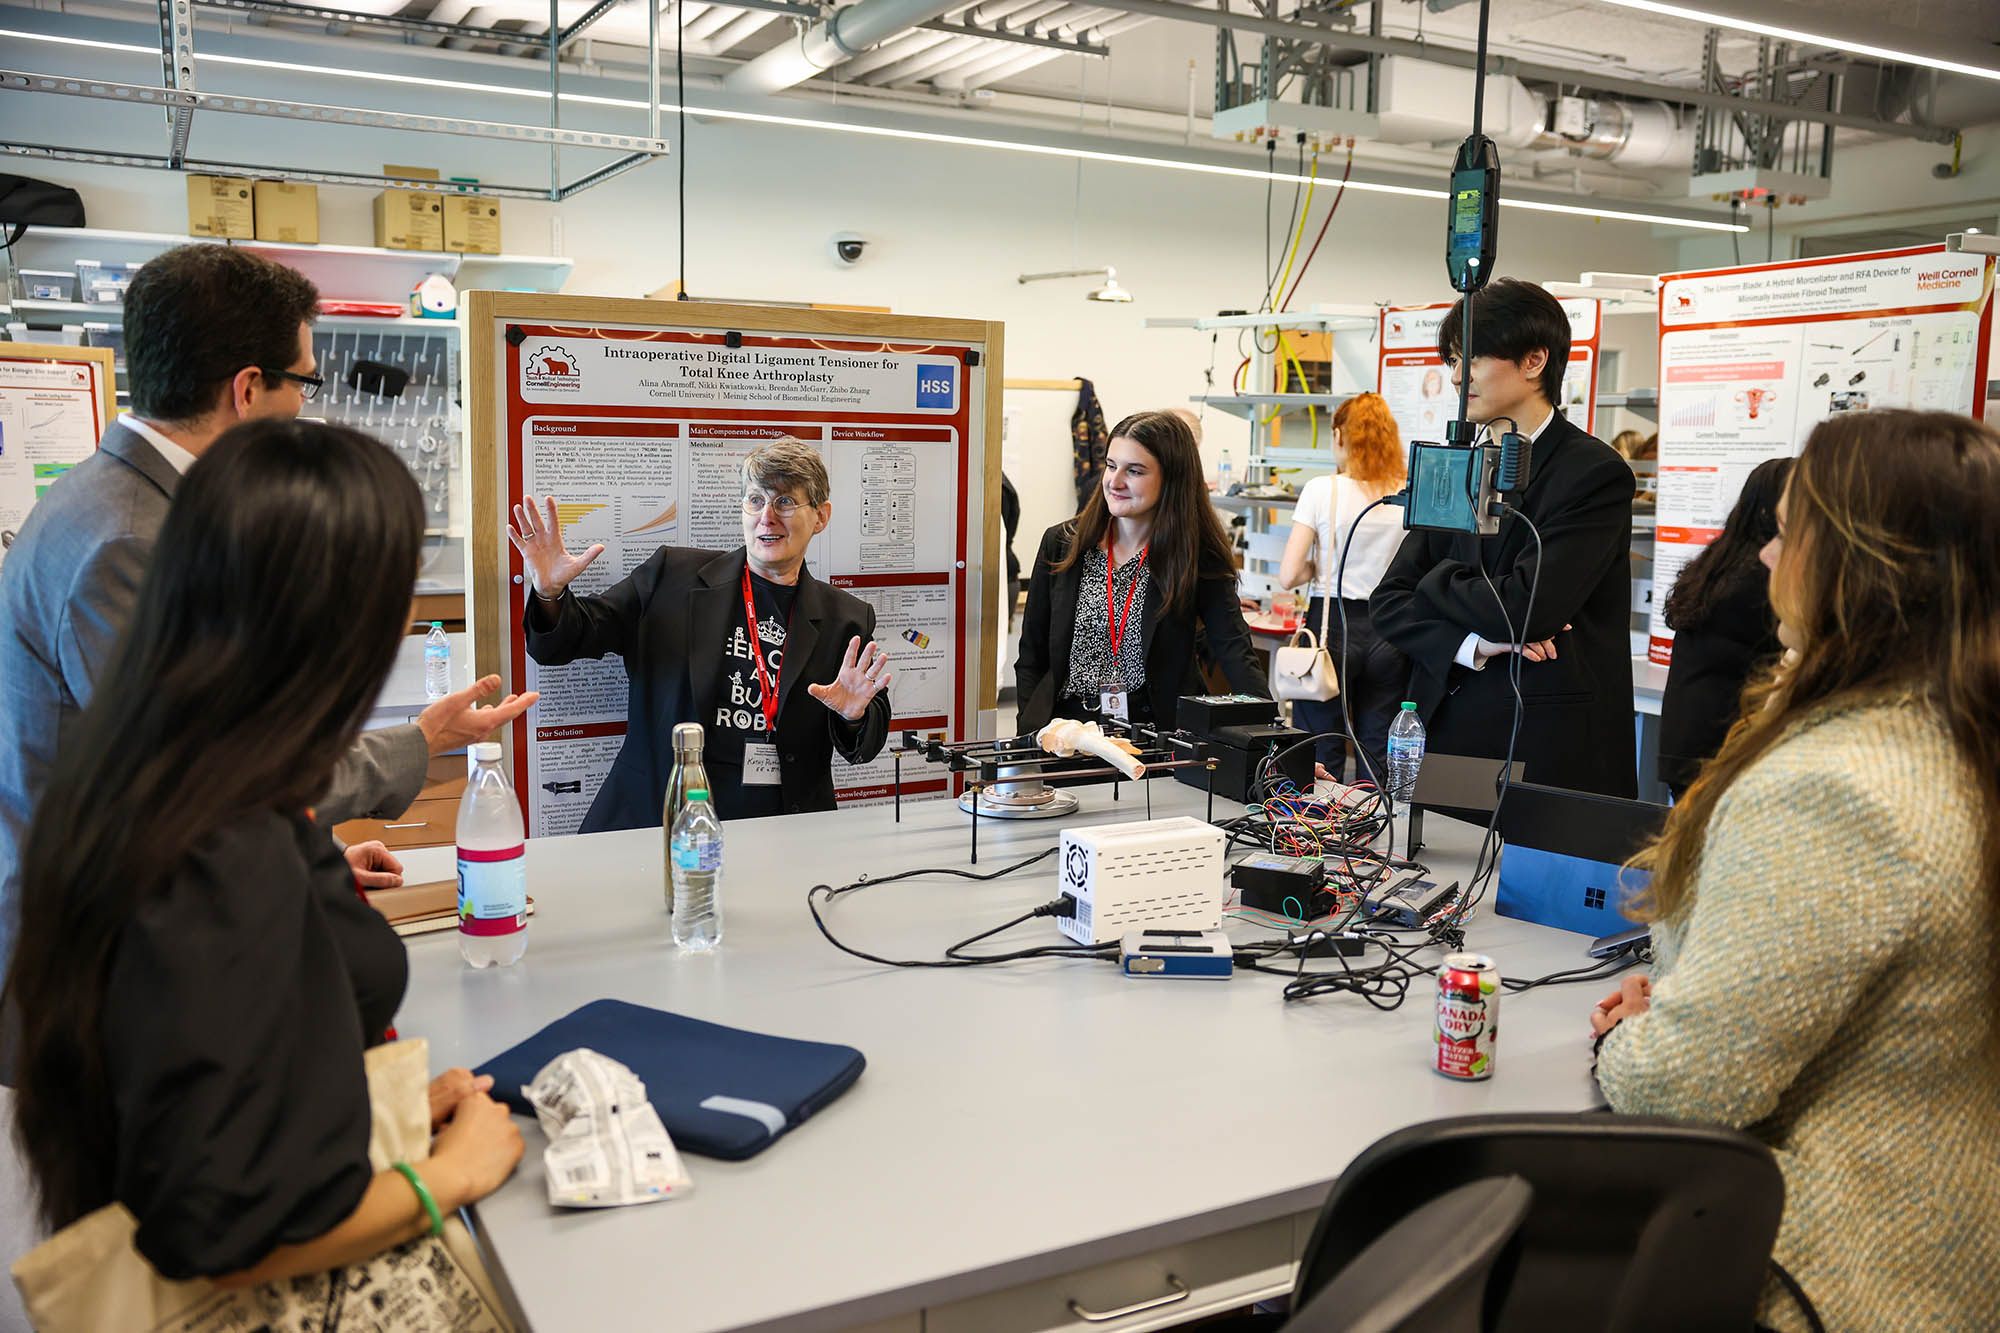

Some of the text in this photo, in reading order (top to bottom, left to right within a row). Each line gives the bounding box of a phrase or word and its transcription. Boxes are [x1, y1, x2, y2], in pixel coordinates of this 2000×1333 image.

[1856, 270, 1871, 279] RFA
[1873, 268, 1899, 278] Device
[1918, 268, 1978, 281] Weill Cornell
[1802, 289, 1827, 298] Fibroid
[1829, 285, 1867, 295] Treatment
[1917, 280, 1961, 291] Medicine
[604, 346, 899, 369] Intraoperative Digital Ligament Tensioner for
[680, 366, 834, 383] Total Knee Arthroplasty
[660, 380, 696, 389] Abramoff,
[698, 381, 717, 389] Nikki
[719, 382, 767, 392] Kwiatkowski,
[768, 383, 798, 392] Brendan
[829, 386, 848, 394] Zhibo
[849, 386, 870, 395] Zhang
[921, 380, 951, 393] HSS
[678, 390, 715, 400] University
[723, 392, 747, 401] Meinig
[749, 392, 772, 401] School
[782, 394, 819, 402] Biomedical
[821, 395, 861, 404] Engineering
[533, 425, 576, 433] Background
[709, 428, 750, 436] Components
[760, 429, 784, 437] Design
[835, 789, 887, 799] cknowledgements
[1437, 1002, 1486, 1021] CANADA
[1445, 1019, 1473, 1032] DRY
